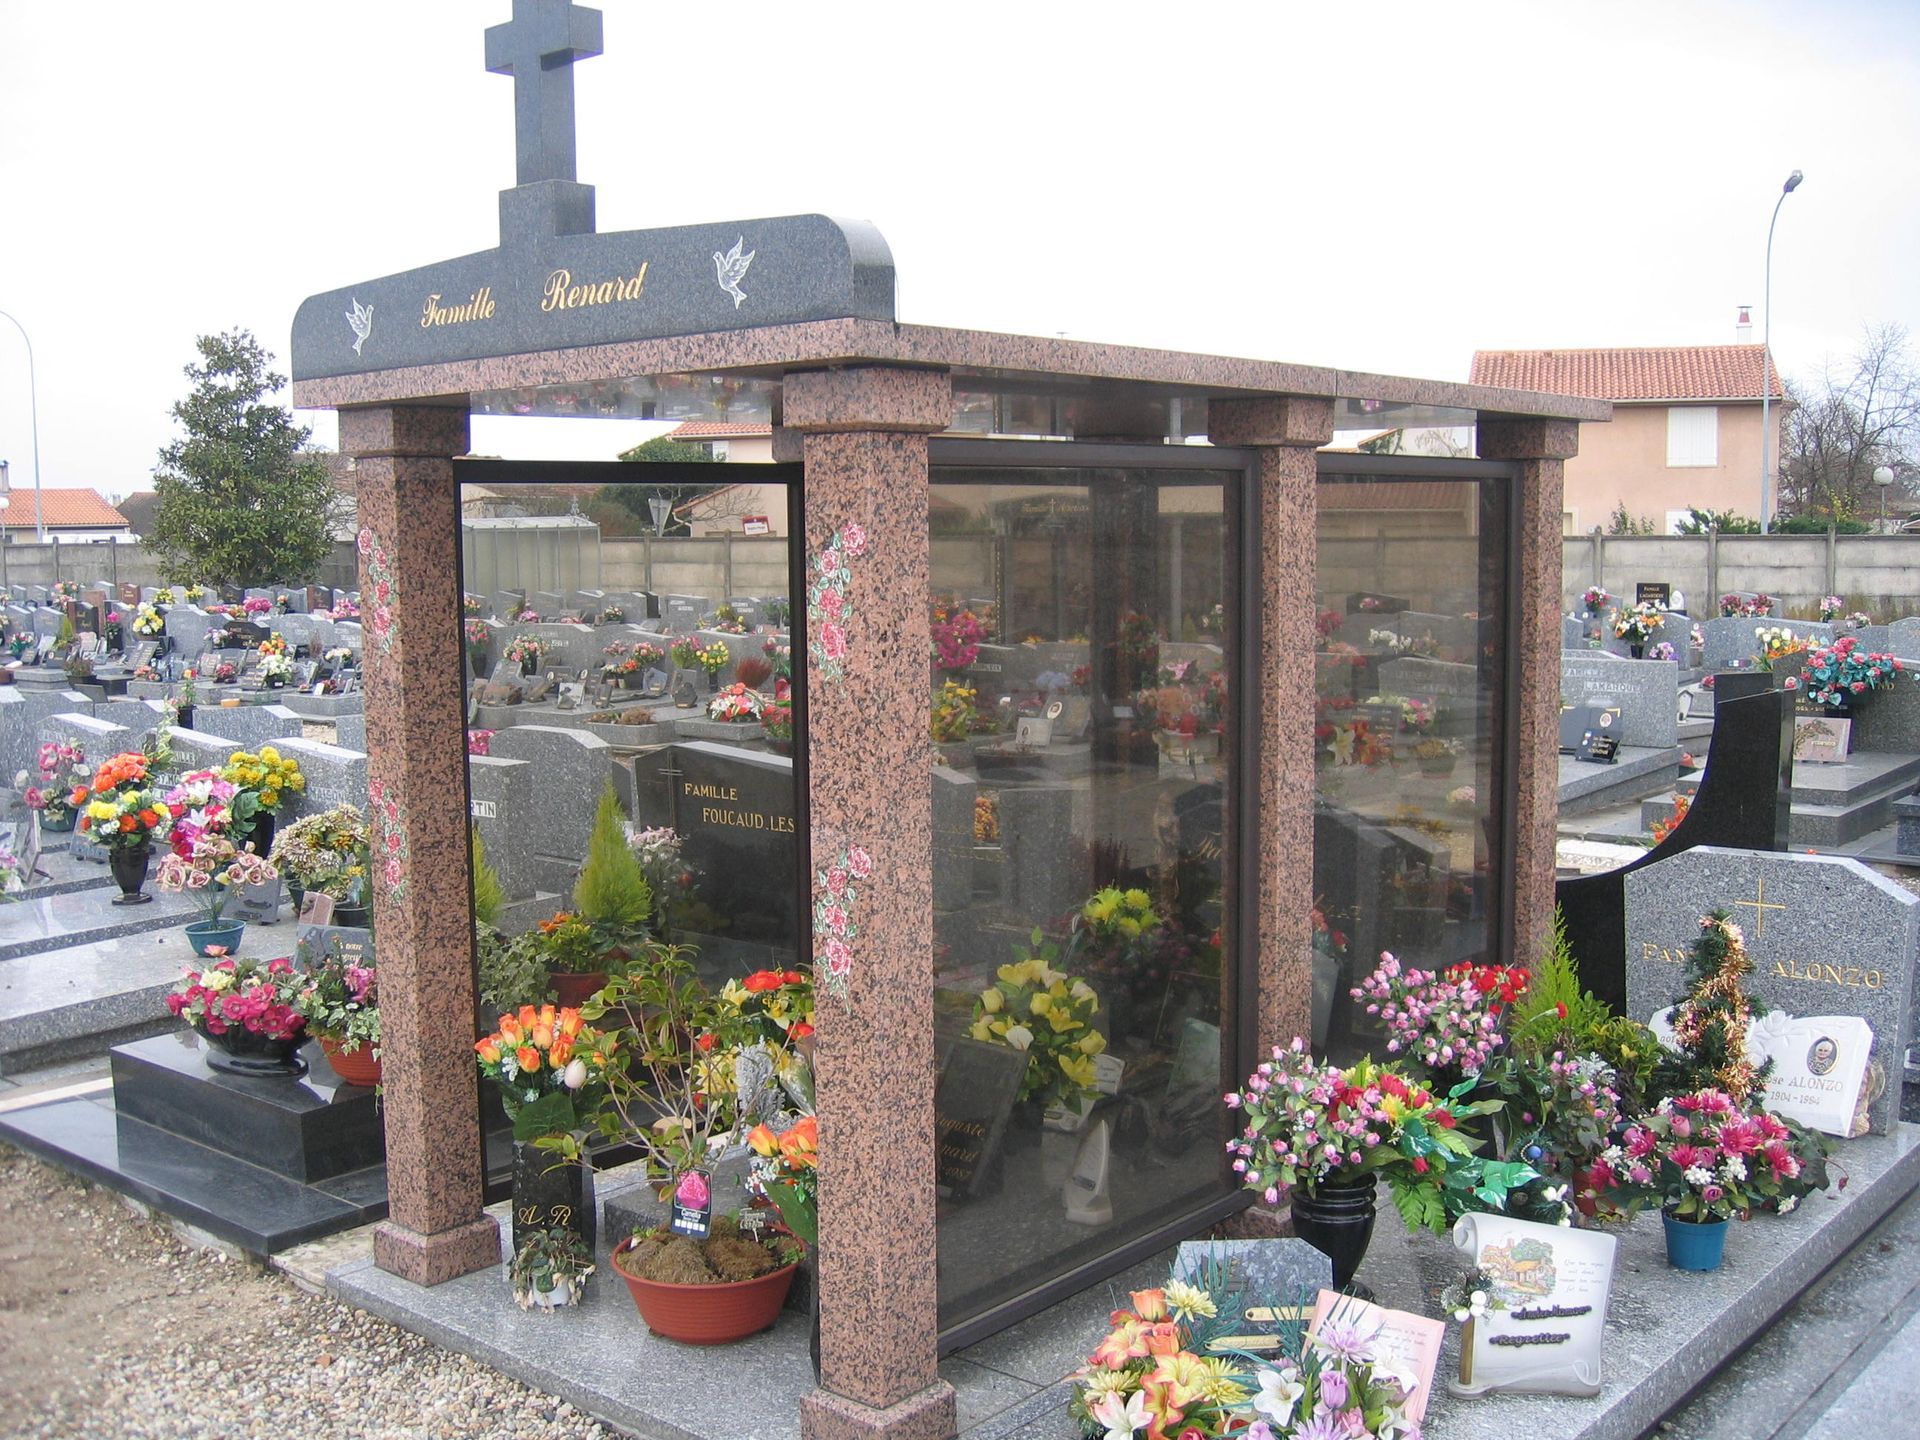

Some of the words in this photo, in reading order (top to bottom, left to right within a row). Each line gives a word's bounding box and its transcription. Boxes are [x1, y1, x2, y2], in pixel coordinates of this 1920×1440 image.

[420, 286, 496, 329] Famille
[541, 261, 649, 312] Renard
[684, 782, 738, 801] FAMILLE
[470, 801, 496, 817] RTIN
[1770, 960, 1883, 989] ALONZO
[1788, 1075, 1844, 1093] ALONZO
